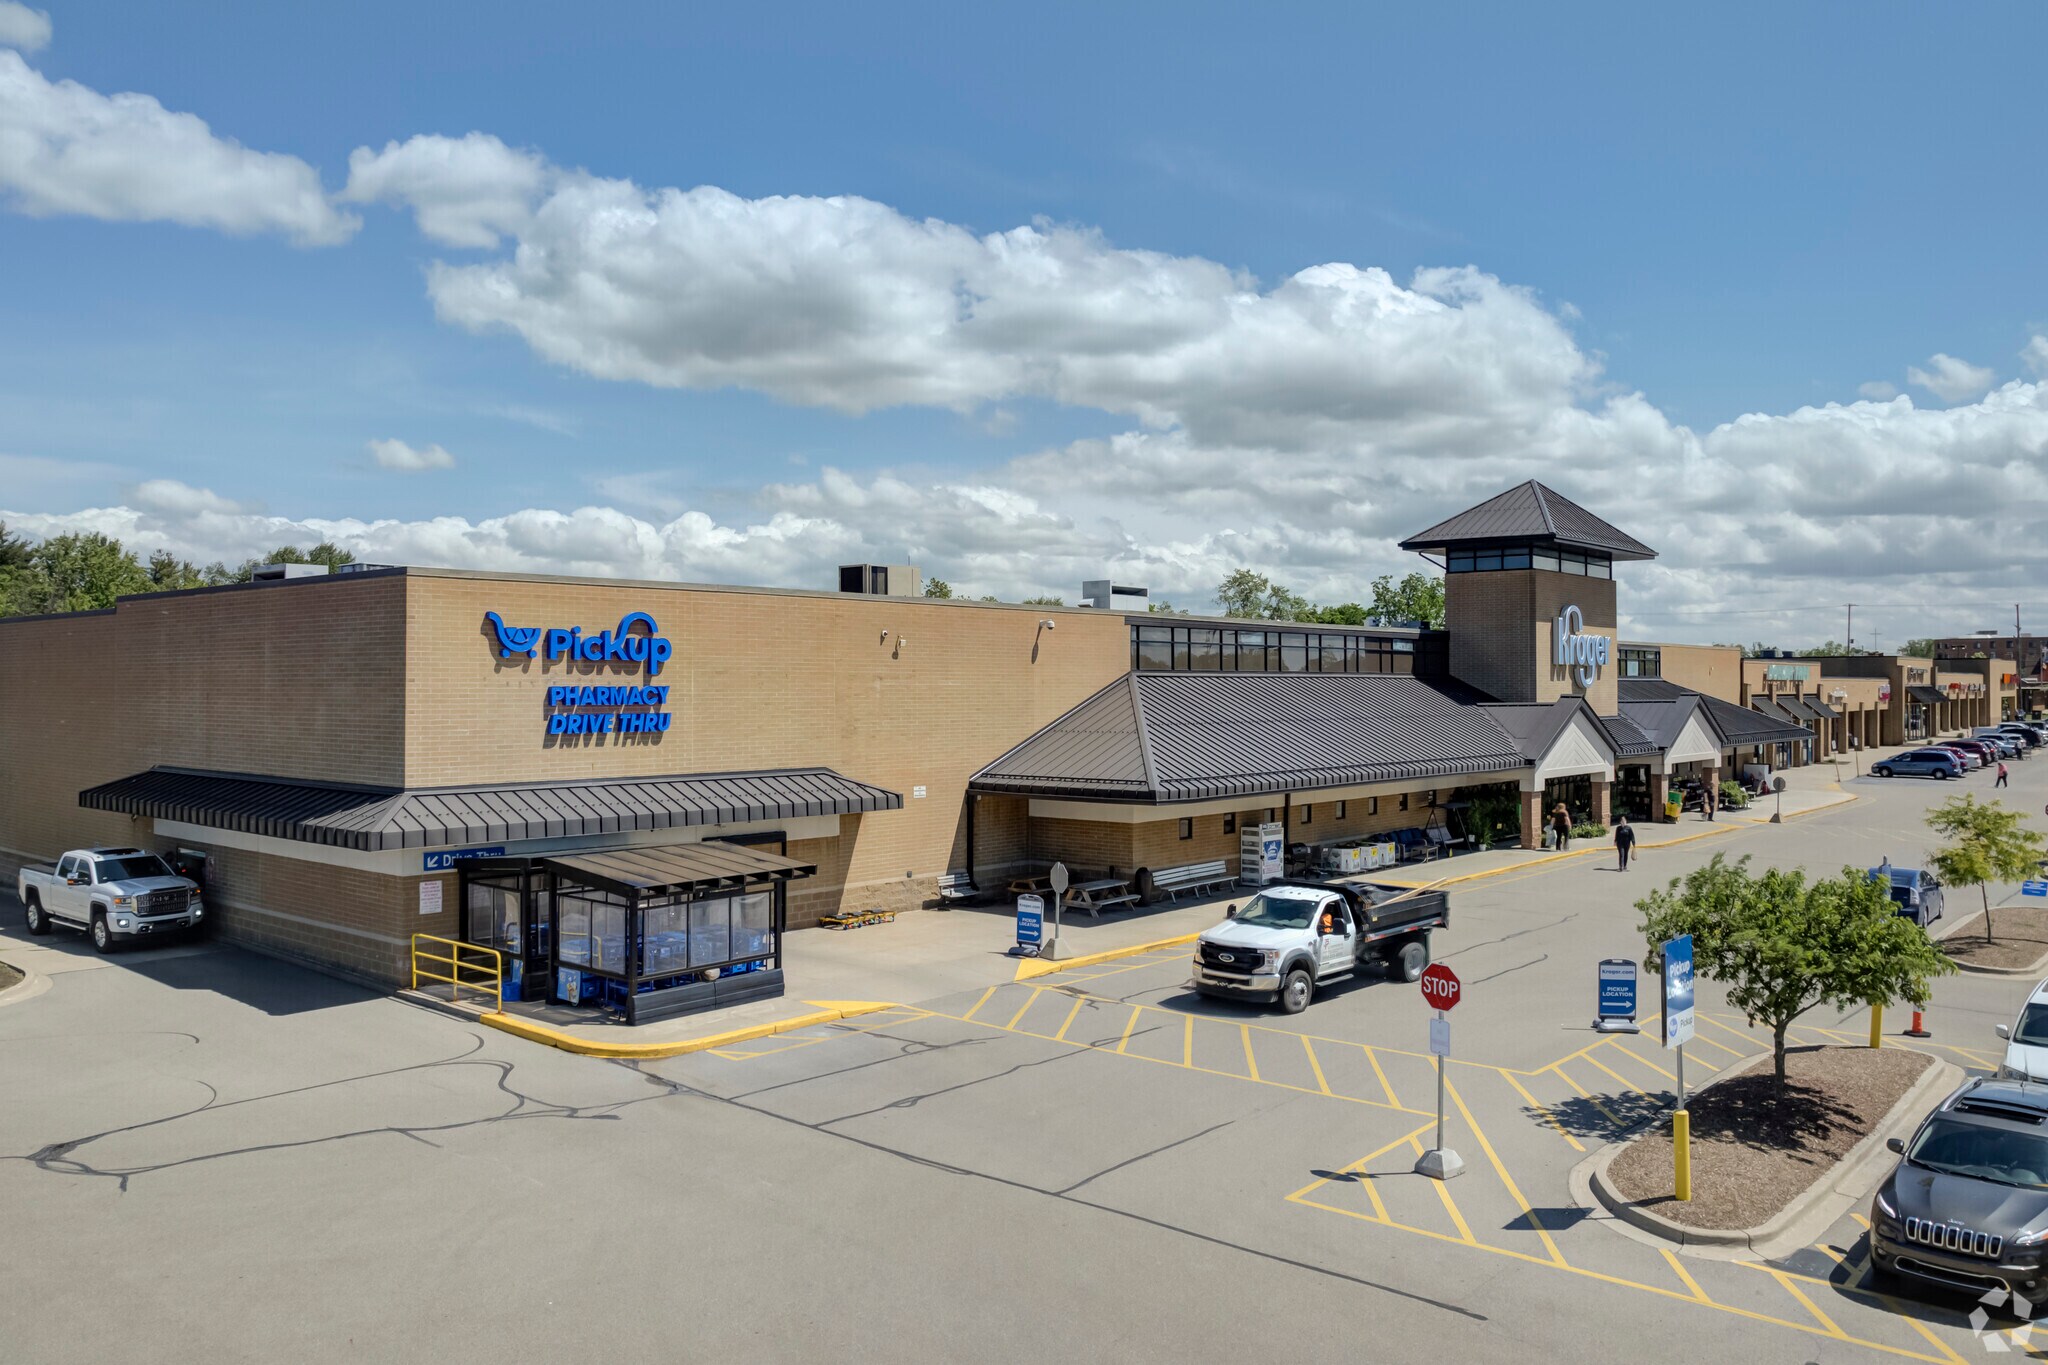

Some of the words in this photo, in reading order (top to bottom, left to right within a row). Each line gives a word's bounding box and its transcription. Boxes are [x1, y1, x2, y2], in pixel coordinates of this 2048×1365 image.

[549, 611, 672, 675] Pickup
[1557, 604, 1611, 688] Kroger
[549, 686, 670, 706] PHARMACY
[550, 714, 615, 734] DRIVE
[618, 713, 672, 732] THRU
[1669, 960, 1690, 978] Pickup
[1423, 975, 1459, 998] STOP
